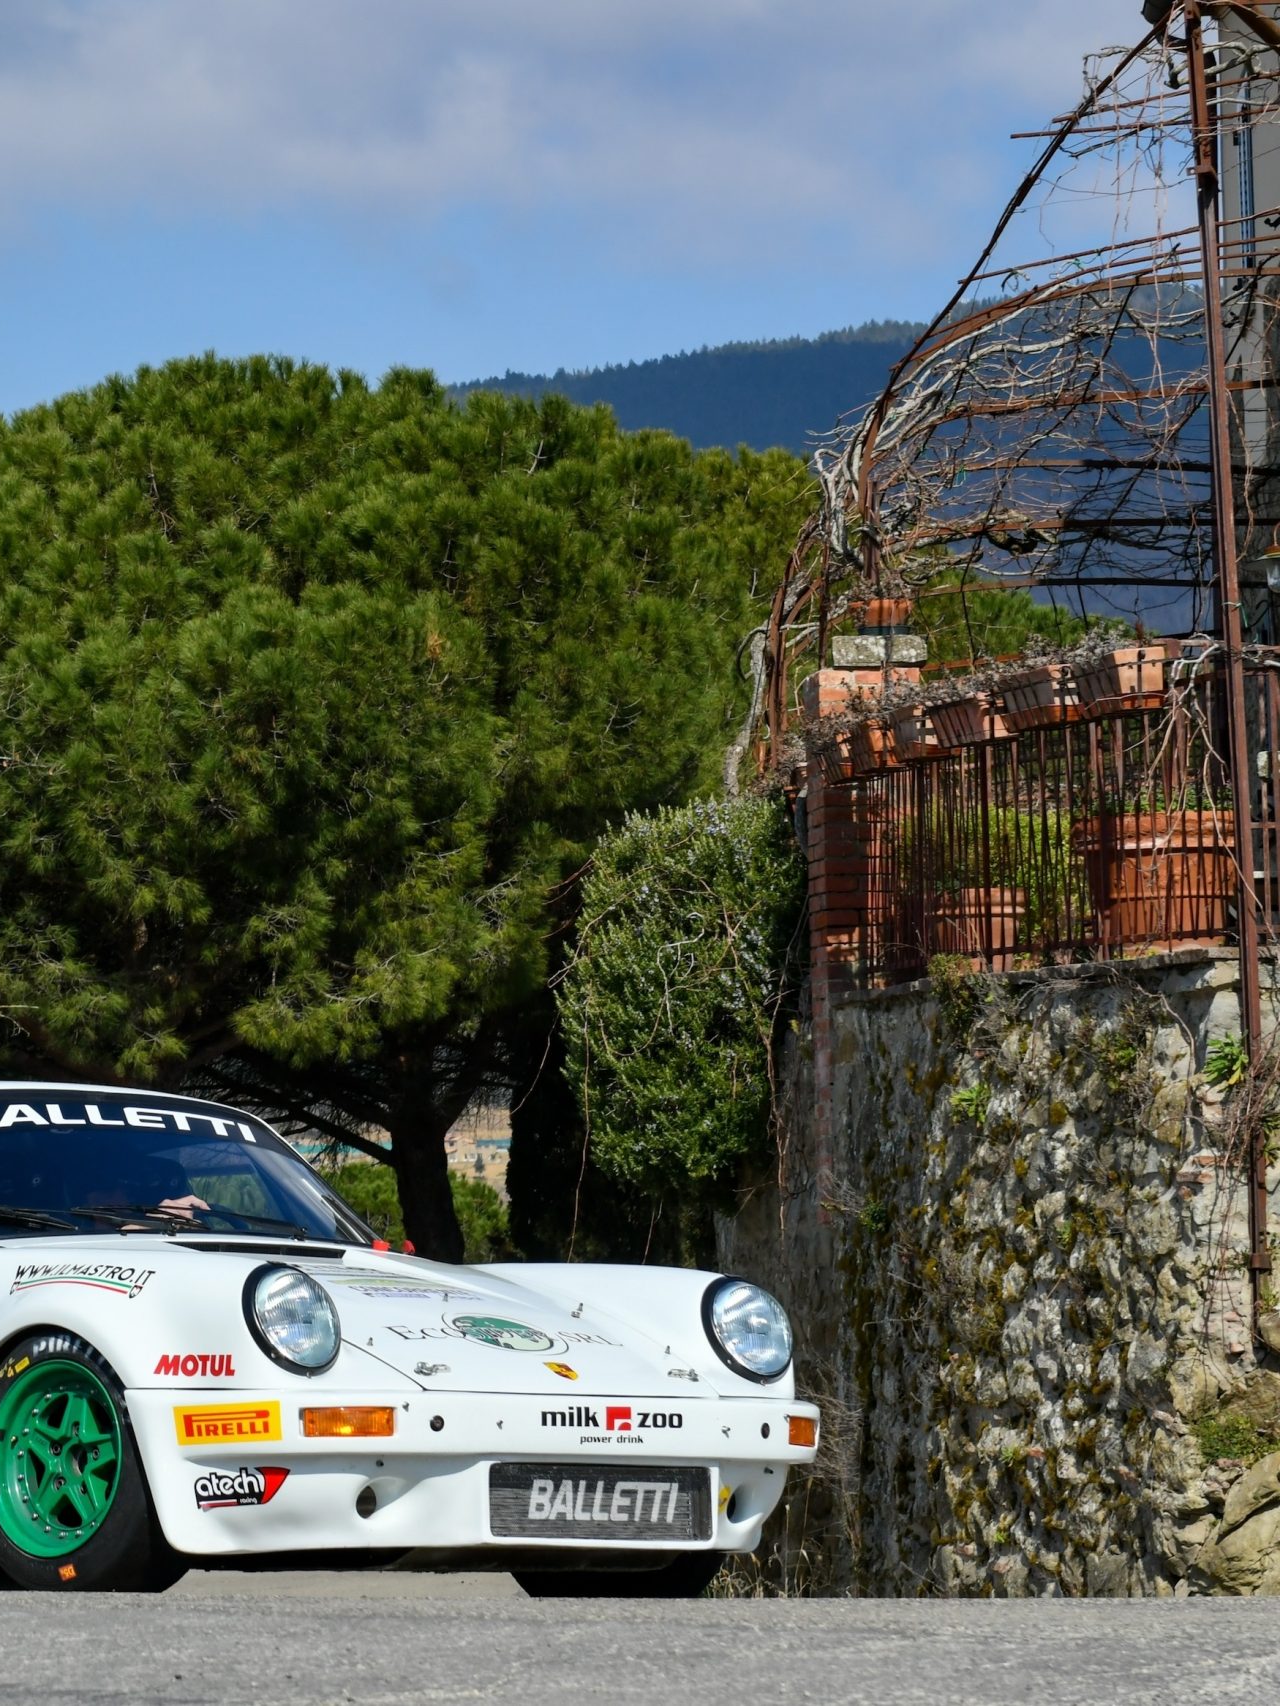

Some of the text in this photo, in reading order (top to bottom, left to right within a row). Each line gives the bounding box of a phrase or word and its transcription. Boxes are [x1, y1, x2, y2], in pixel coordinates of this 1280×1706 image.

[15, 1264, 156, 1285] WWW.ILMASTRO.IT
[153, 1354, 235, 1377] MOTUL
[183, 1410, 270, 1437] PIRELLI
[541, 1406, 683, 1428] milk zoo
[580, 1434, 644, 1444] power drink
[528, 1479, 679, 1524] BALLETTI
